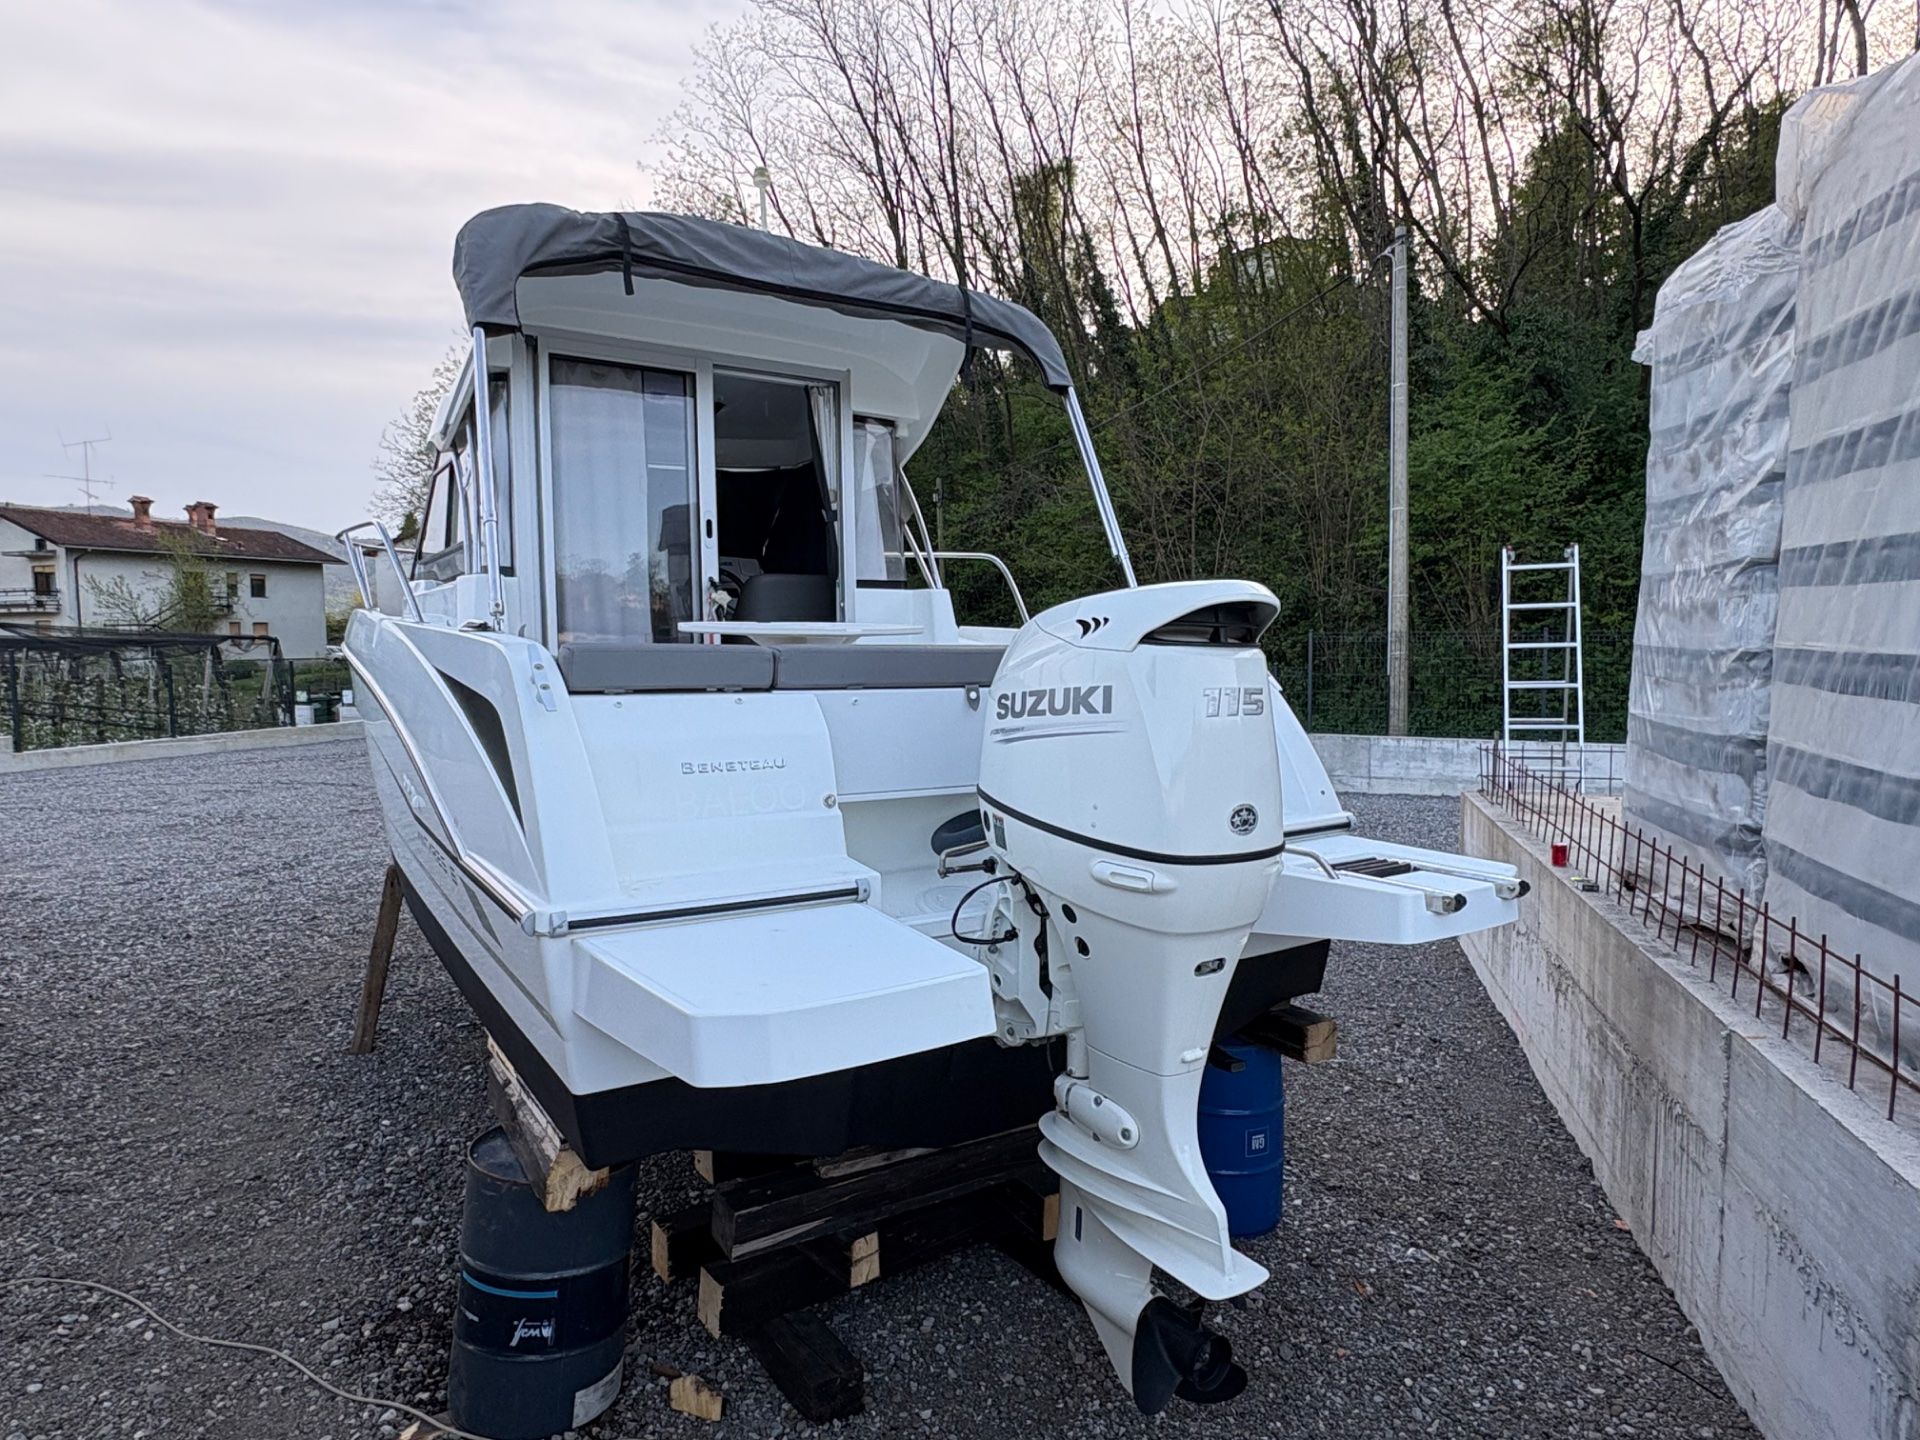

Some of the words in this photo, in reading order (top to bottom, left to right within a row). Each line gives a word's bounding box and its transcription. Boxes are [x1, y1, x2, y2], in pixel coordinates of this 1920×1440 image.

[997, 685, 1113, 720] SUZUKI
[1202, 687, 1264, 718] 115
[681, 757, 786, 775] BENETEAU
